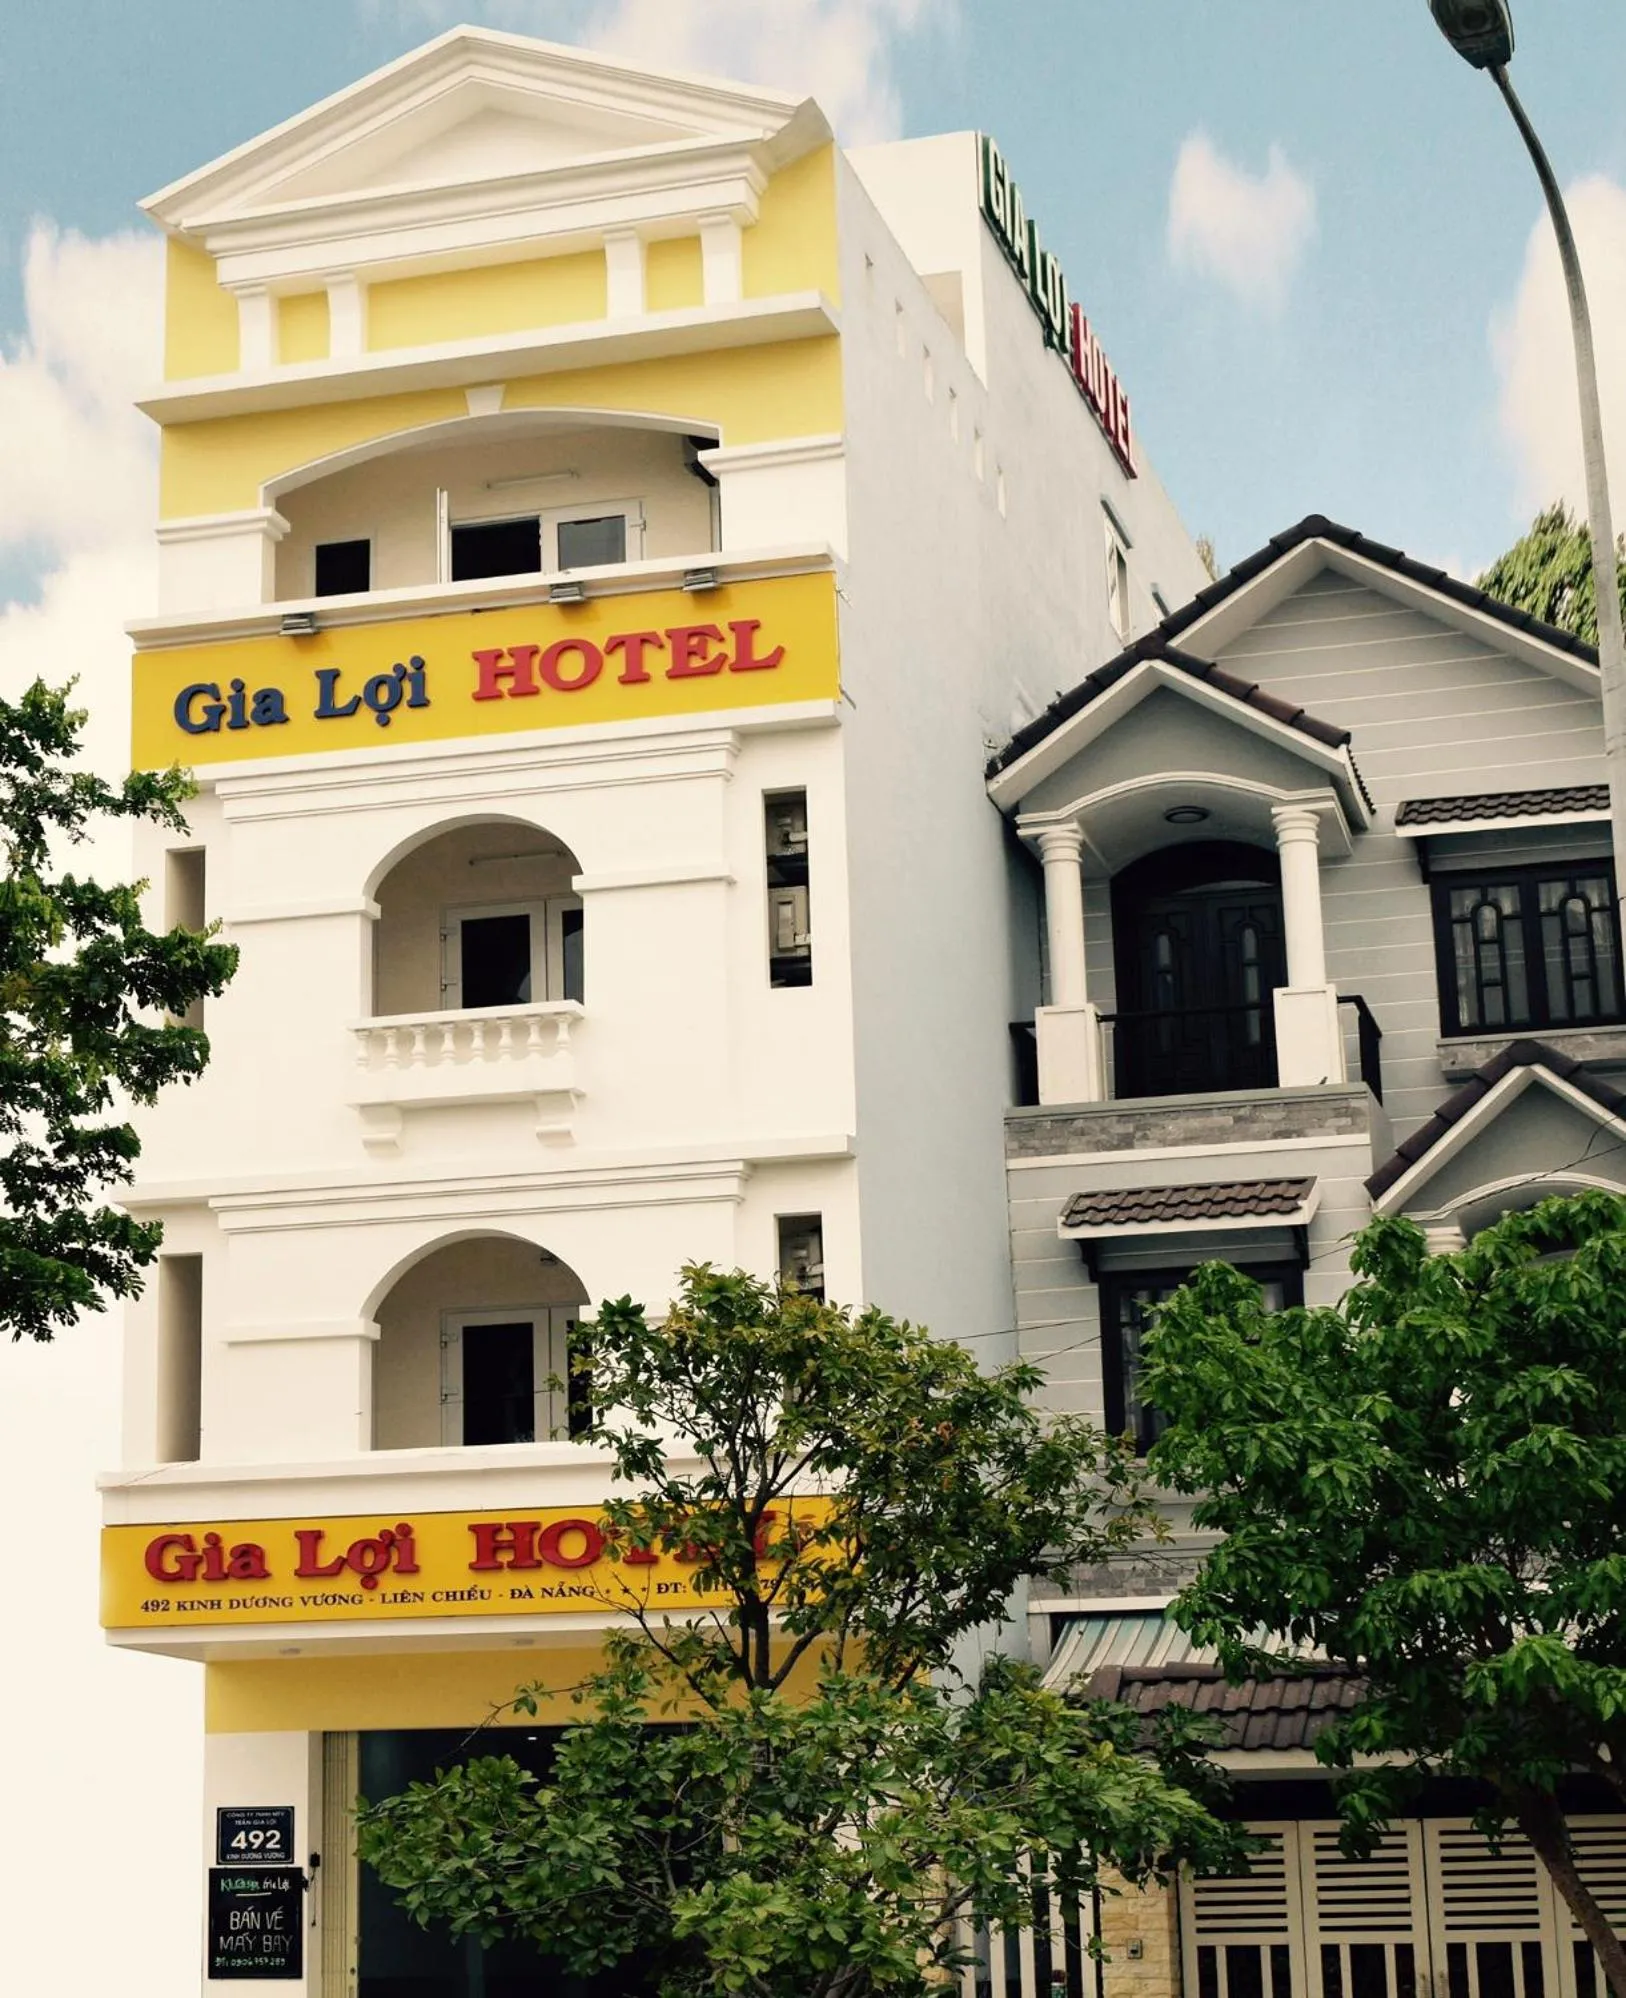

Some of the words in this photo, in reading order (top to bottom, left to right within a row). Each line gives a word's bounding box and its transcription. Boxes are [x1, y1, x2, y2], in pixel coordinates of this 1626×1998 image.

[979, 133, 1029, 280] GIA
[173, 681, 288, 734] Gia
[313, 655, 430, 727] Lợi
[471, 618, 785, 701] HOTEL
[144, 1531, 272, 1582] Gia
[293, 1522, 420, 1590] Lợi
[140, 1599, 170, 1613] 492
[175, 1599, 222, 1612] KINH
[381, 1589, 425, 1604] LIÊN
[510, 1584, 535, 1600] ĐÀ
[656, 1582, 687, 1594] ĐT:
[231, 1829, 281, 1850] 492
[220, 1932, 257, 1952] MÁY
[263, 1934, 294, 1954] BAY
